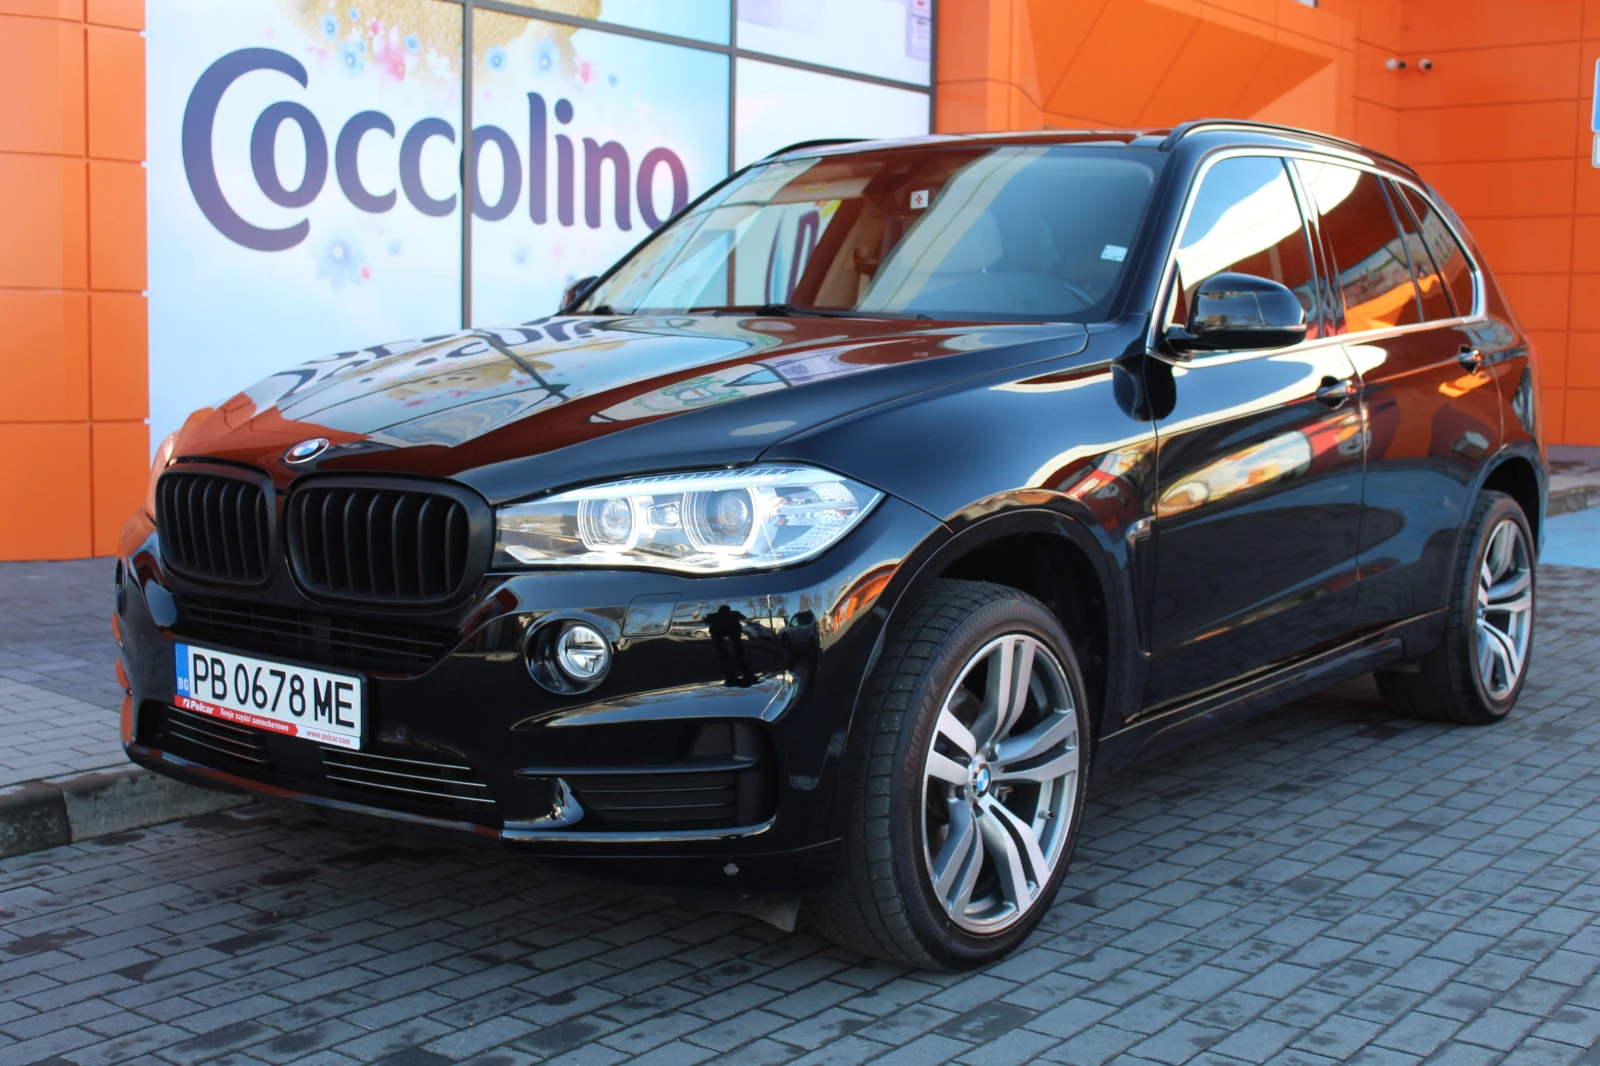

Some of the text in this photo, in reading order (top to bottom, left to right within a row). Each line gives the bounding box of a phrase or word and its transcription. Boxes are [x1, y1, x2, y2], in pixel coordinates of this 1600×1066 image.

[182, 47, 689, 252] Coccolino
[178, 676, 189, 691] BG
[193, 653, 355, 728] PB 0678 ME
[190, 700, 214, 715] Polcar
[306, 730, 351, 745] www.polcar.com
